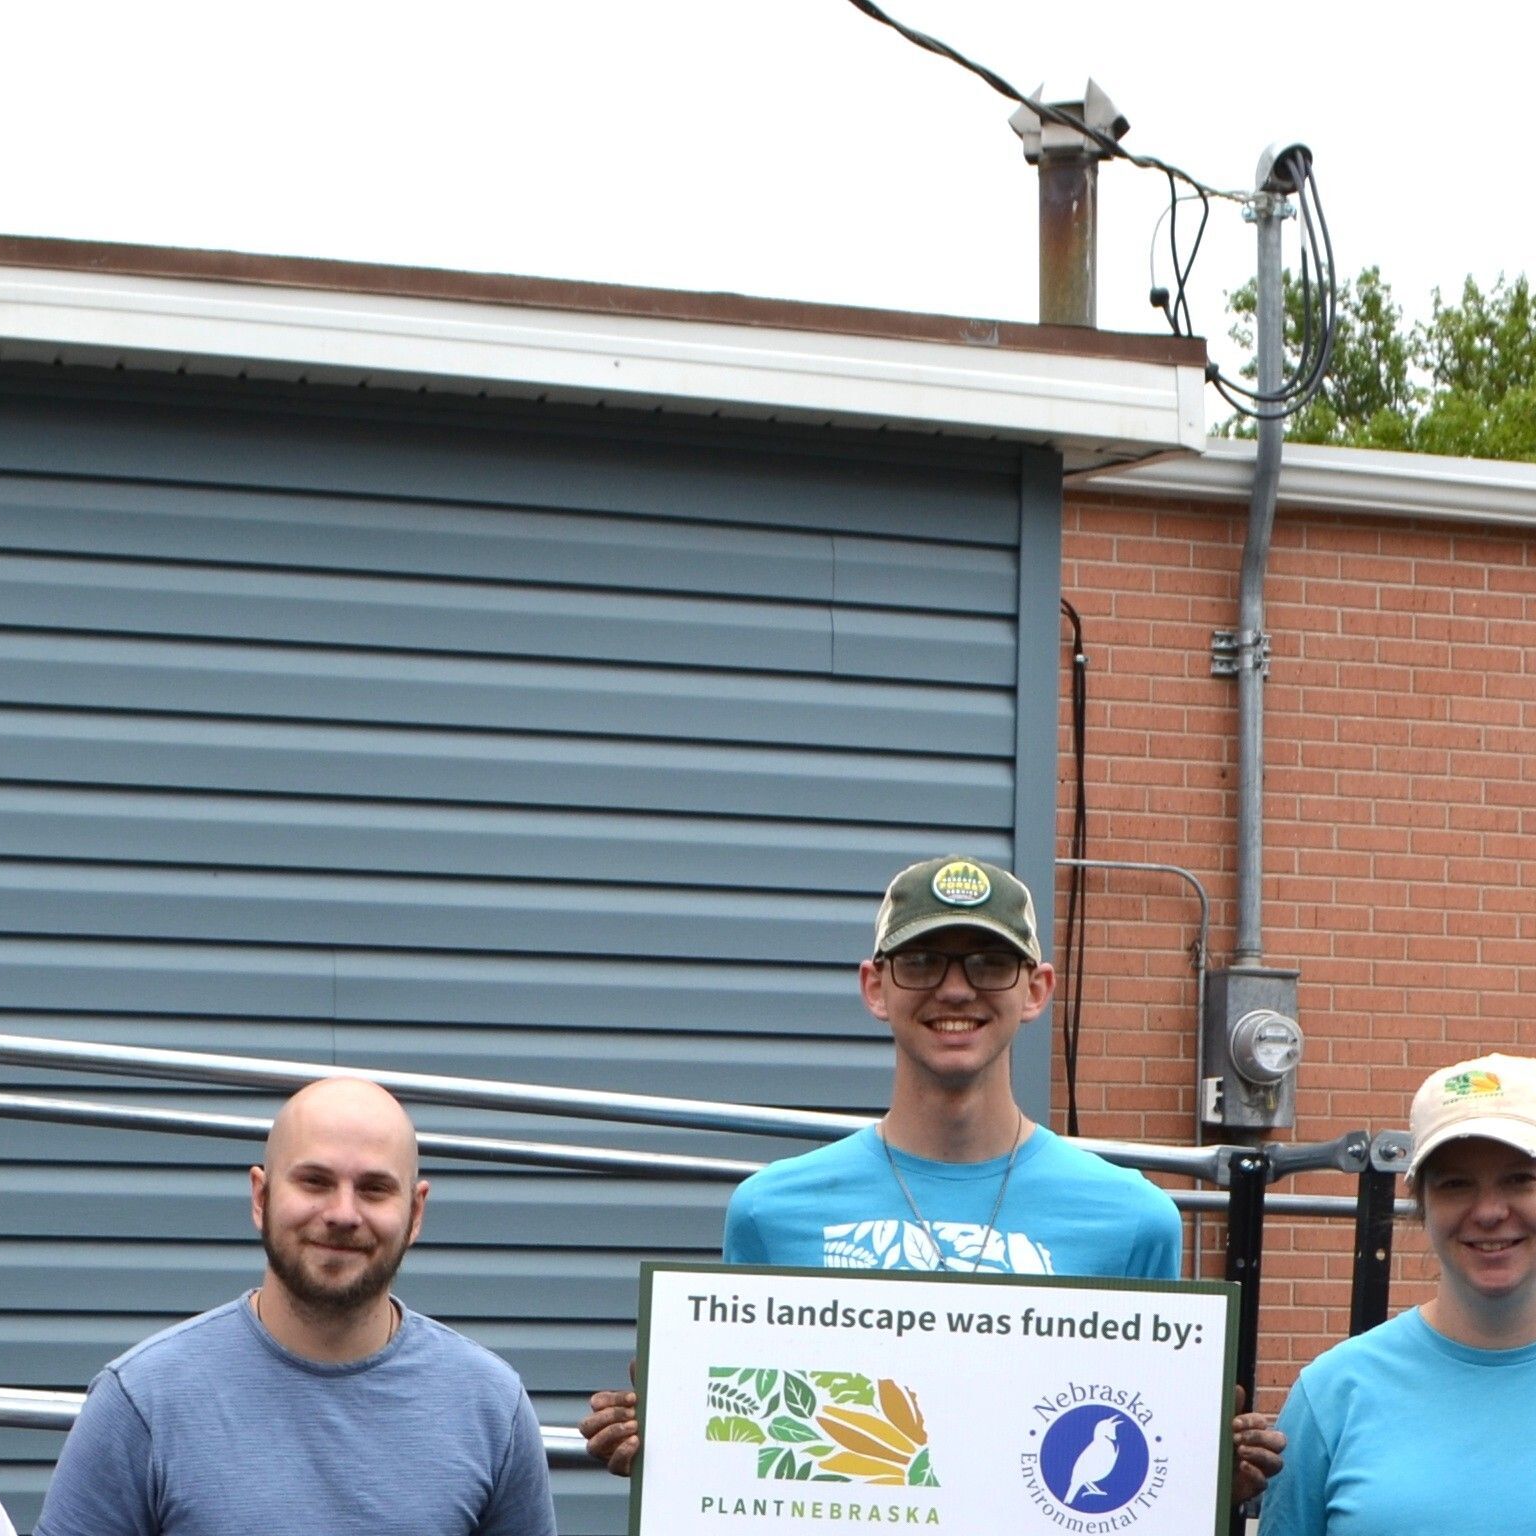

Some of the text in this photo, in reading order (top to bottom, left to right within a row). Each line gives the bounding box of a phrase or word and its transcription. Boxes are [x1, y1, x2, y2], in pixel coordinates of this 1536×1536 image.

[688, 1295, 1203, 1350] This landscape was funded by:
[1032, 1381, 1154, 1427] Nebraska
[700, 1495, 941, 1525] PLANTNEBRASKA
[1020, 1452, 1169, 1535] Environmental Trust
